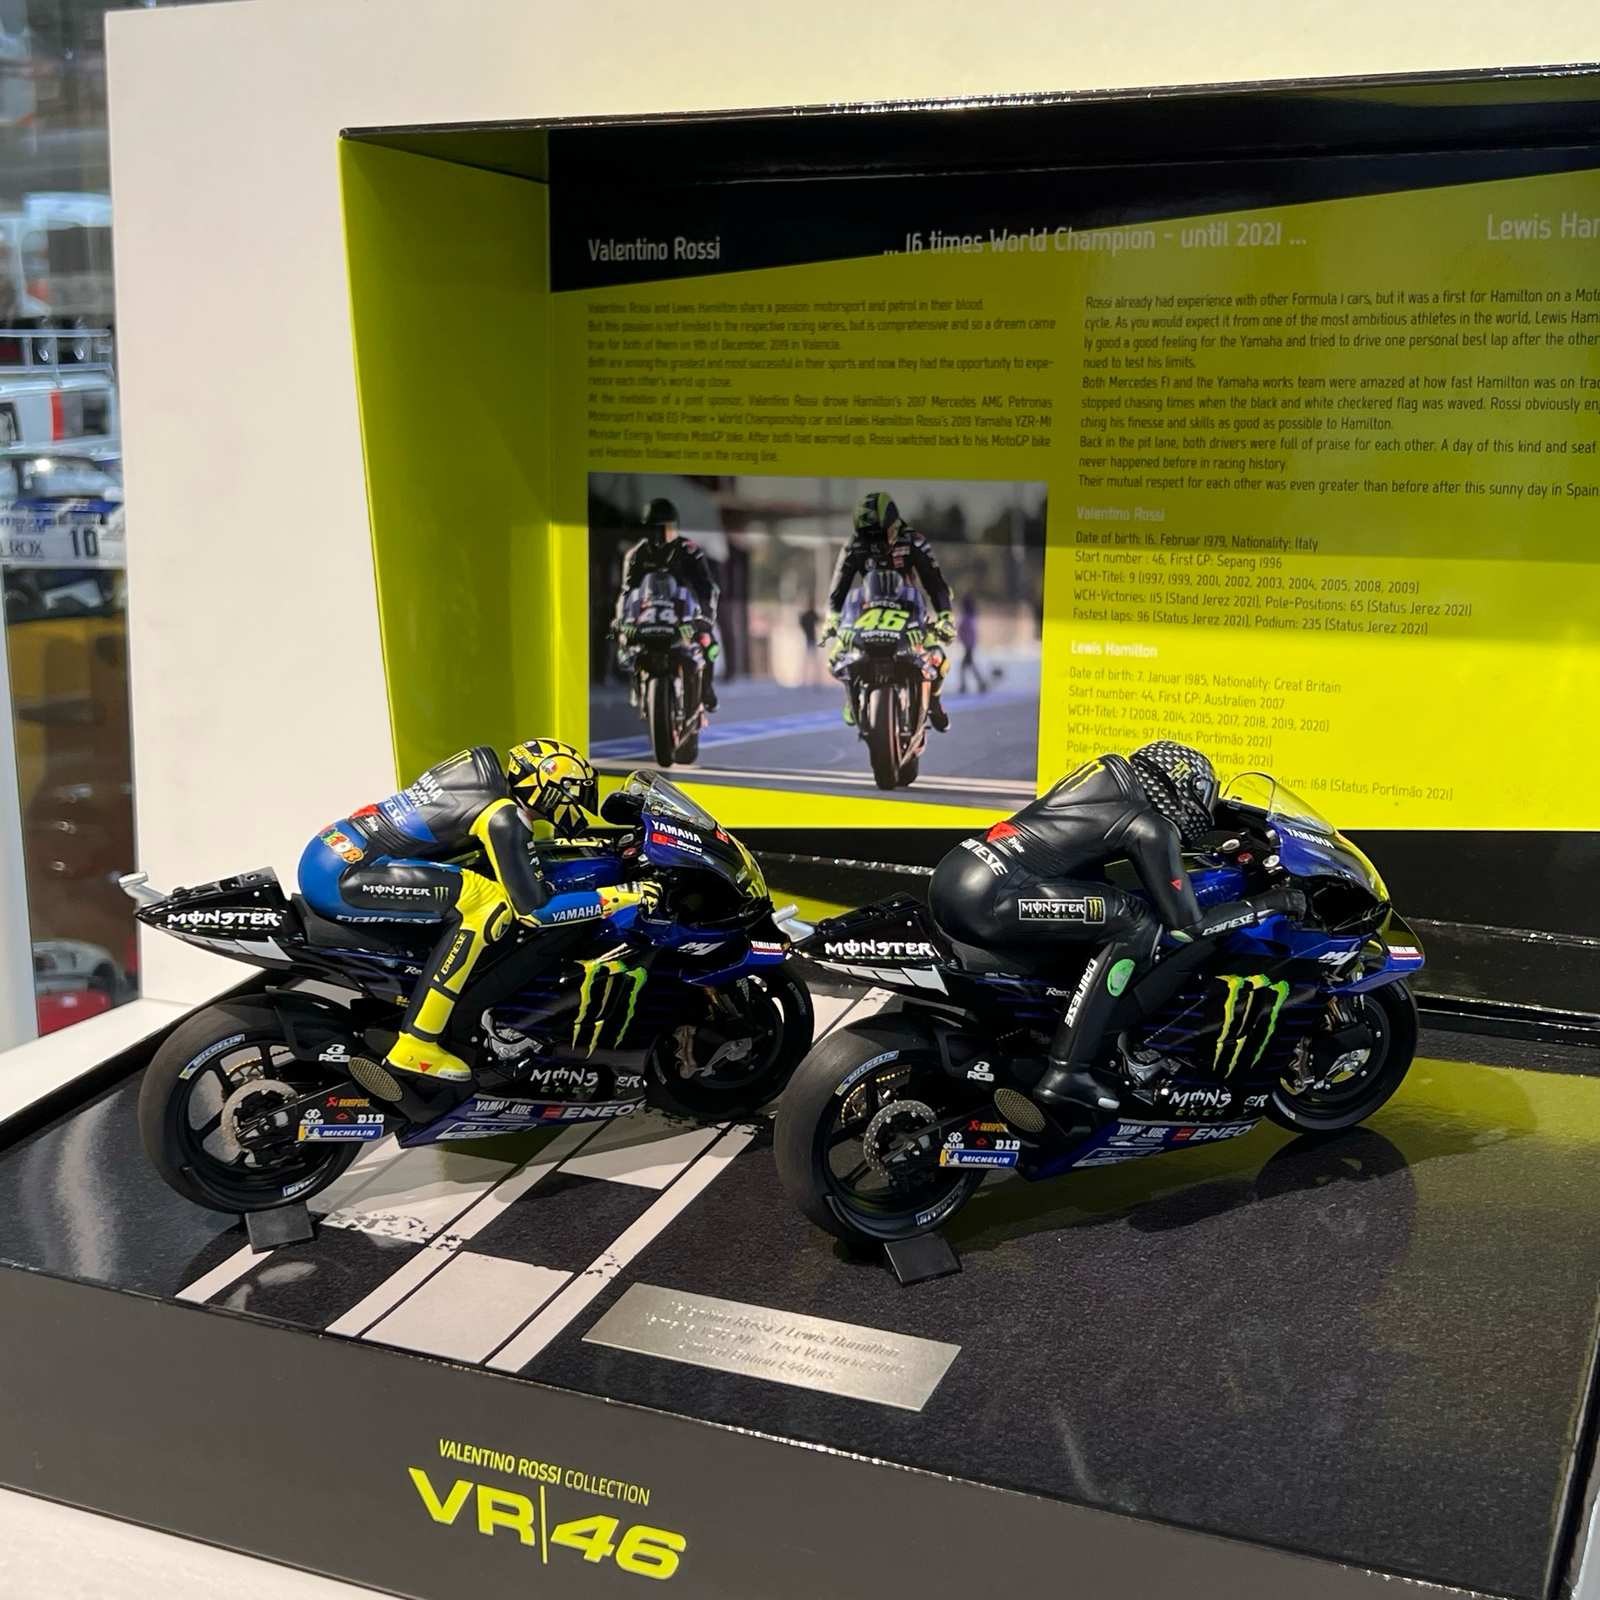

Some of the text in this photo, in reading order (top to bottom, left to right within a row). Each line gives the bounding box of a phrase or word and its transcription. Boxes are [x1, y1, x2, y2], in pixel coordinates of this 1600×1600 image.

[1487, 213, 1552, 241] Lewis
[587, 236, 721, 262] Valentino Rossi
[905, 234, 922, 255] 16
[928, 230, 983, 255] times
[989, 226, 1046, 253] World
[1054, 225, 1156, 257] Champion
[1181, 222, 1230, 249] until
[1237, 222, 1281, 247] 2021
[1083, 356, 1196, 369] nued to test his limits.
[1080, 416, 1392, 433] ching his finesse and skills as good as possible to Hamilton.
[1078, 456, 1287, 473] never happened before in racing history.
[1076, 506, 1164, 521] Valentino Rossi
[1075, 532, 1098, 545] Date
[1100, 533, 1111, 545] of
[1114, 533, 1142, 546] birth:
[1159, 534, 1199, 547] Februar
[1231, 536, 1292, 553] Nationality:
[1294, 537, 1318, 554] Italy
[1075, 552, 1099, 564] Start
[1103, 552, 1140, 565] number
[1170, 553, 1192, 566] First
[1217, 555, 1255, 572] Sepang
[1073, 589, 1145, 604] WCH-Victories:
[1165, 591, 1198, 607] (Stand
[1202, 594, 1229, 607] Jerez
[1265, 596, 1347, 611] Pole-Positions:
[1350, 599, 1363, 612] 65
[1367, 599, 1406, 615] (Status
[1410, 601, 1440, 615] Jerez
[639, 608, 678, 624] 44
[853, 608, 910, 630] 46
[1071, 641, 1157, 658] Lewis Hamilton
[1069, 667, 1091, 680] Date
[1094, 668, 1104, 681] of
[1107, 668, 1134, 682] birth:
[1148, 670, 1179, 684] Januar
[1212, 673, 1271, 692] Nationality:
[1274, 677, 1302, 691] Great
[1305, 678, 1340, 693] Britain
[1068, 704, 1116, 719] WCH-Titel:
[1121, 707, 1126, 720] 7
[1129, 707, 1159, 723] (2008,
[1300, 716, 1329, 733] 2020)
[1067, 723, 1138, 740] WCH-Victories:
[1142, 727, 1153, 740] 97
[1157, 727, 1192, 744] (Status
[1196, 730, 1243, 746] Portimão
[1330, 778, 1368, 796] (Status
[1371, 782, 1422, 799] Portimão
[651, 819, 703, 844] YAMAHA
[1283, 826, 1336, 850] YAMAHA
[362, 884, 431, 899] MONSTER
[167, 909, 283, 927] MONSTER
[551, 902, 603, 923] YAMAHA
[1021, 901, 1085, 914] MONSTER
[824, 938, 936, 958] MONSTER
[322, 1129, 376, 1137] MICHELIN
[961, 1155, 1011, 1164] MICHELIN
[438, 1438, 651, 1507] VALENTINO ROSSI COLLECTION
